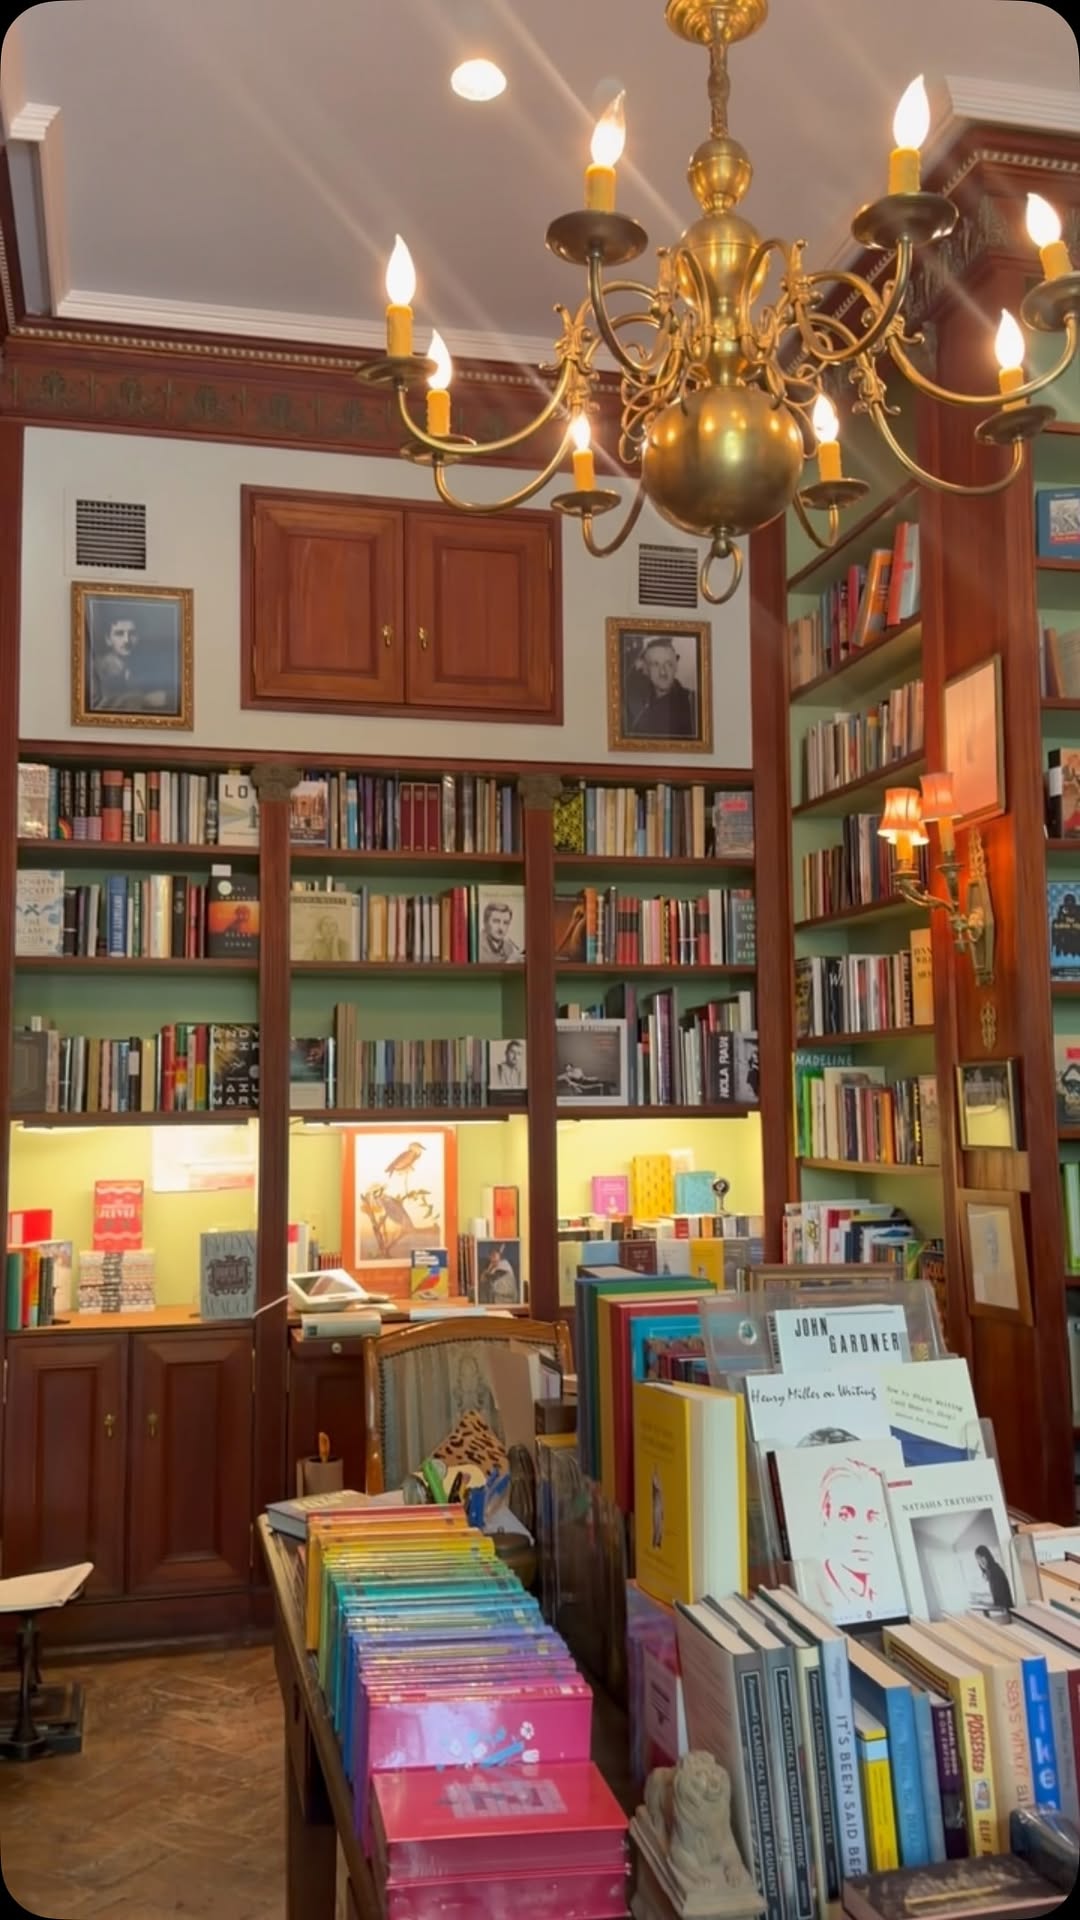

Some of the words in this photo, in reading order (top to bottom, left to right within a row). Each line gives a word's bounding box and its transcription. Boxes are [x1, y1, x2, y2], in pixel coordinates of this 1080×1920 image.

[795, 1317, 828, 1337] JOHN
[829, 1332, 900, 1353] GARDNER
[751, 1389, 785, 1406] Henry
[787, 1384, 820, 1400] Miller
[823, 1390, 835, 1399] on
[837, 1383, 877, 1400] Writing
[901, 1500, 942, 1512] NATASHA
[967, 1687, 978, 1708] THE
[836, 1715, 851, 1745] IT'S
[965, 1712, 985, 1773] POSSESSED
[839, 1751, 854, 1795] BEEN
[843, 1801, 858, 1840] SAID
[978, 1819, 993, 1843] ELIF
